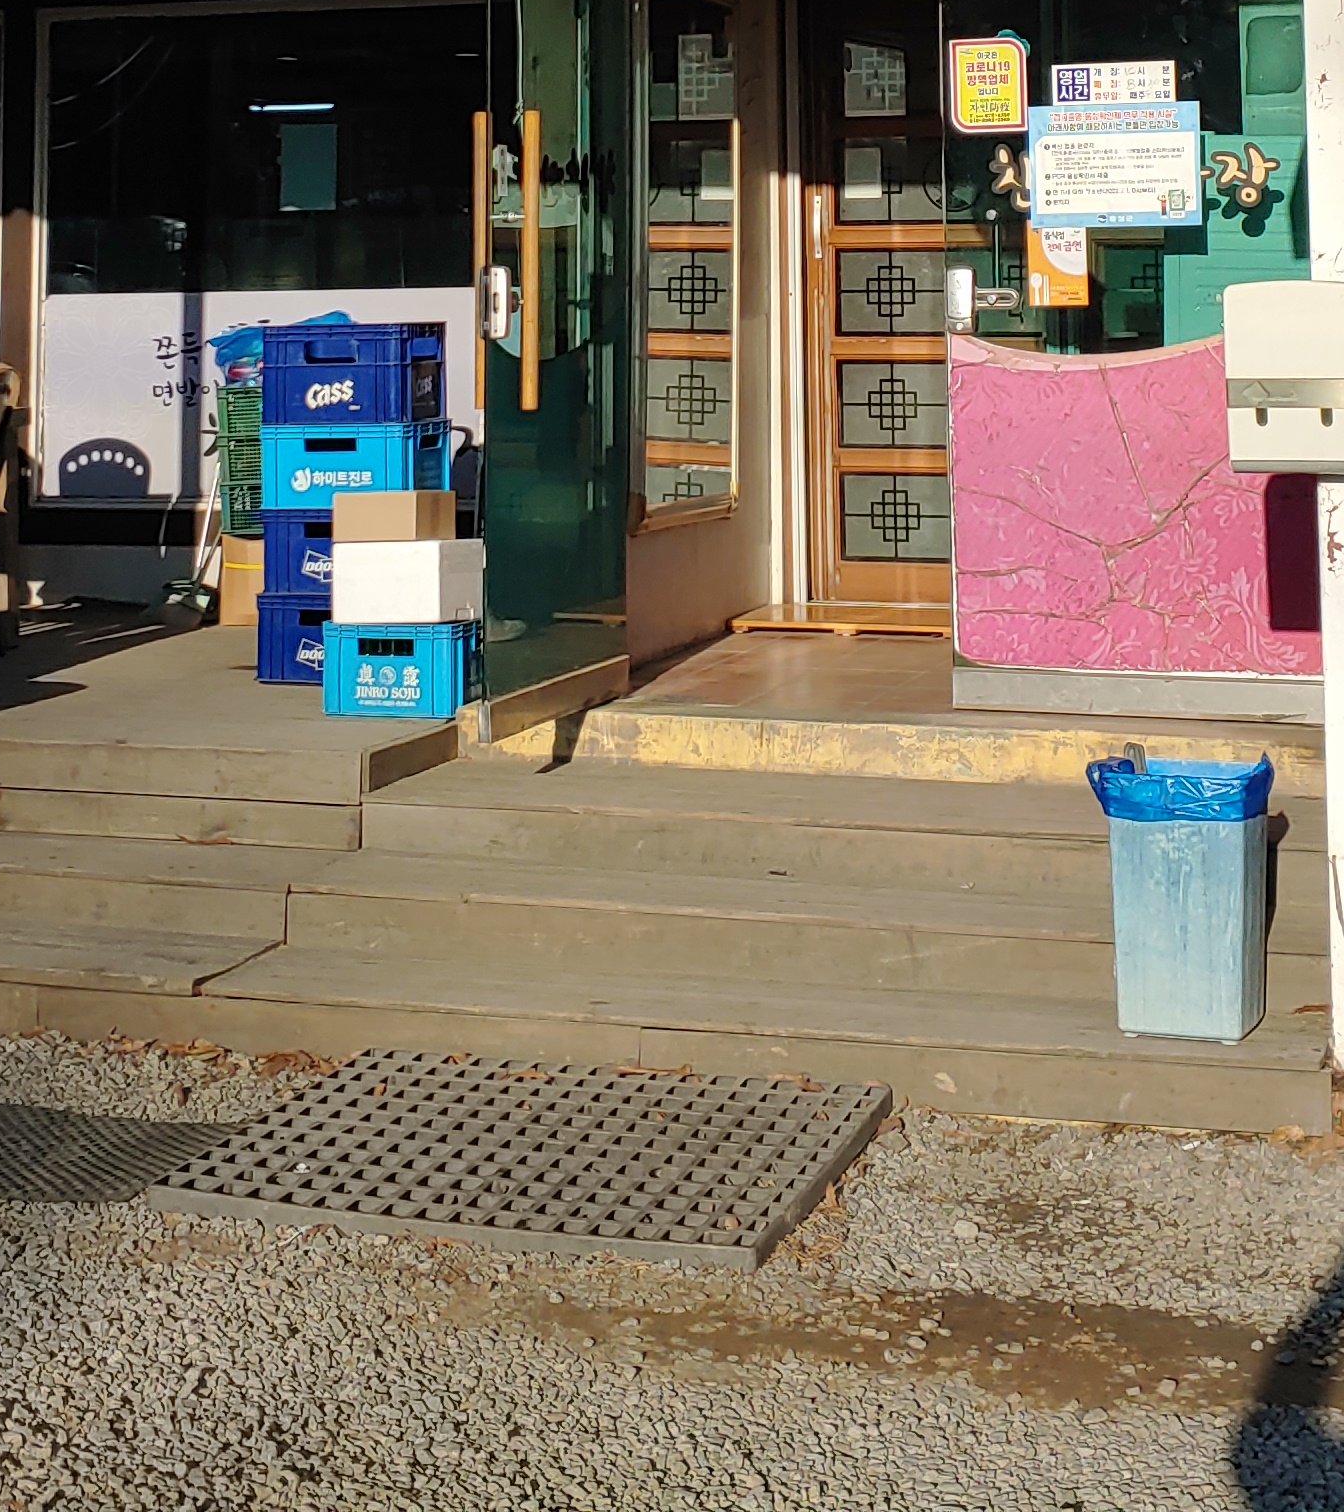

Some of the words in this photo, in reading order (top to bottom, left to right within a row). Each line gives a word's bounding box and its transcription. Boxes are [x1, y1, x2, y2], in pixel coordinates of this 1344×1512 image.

[965, 60, 1011, 73] 코로나19
[966, 74, 1009, 87] 방역업체
[1058, 69, 1089, 85] 영업
[1058, 85, 1089, 101] 시간
[1062, 239, 1082, 252] 금연
[152, 331, 208, 370] 쫀득
[304, 379, 355, 410] Cass
[354, 685, 389, 700] JINRO
[390, 687, 421, 701] SOJU
